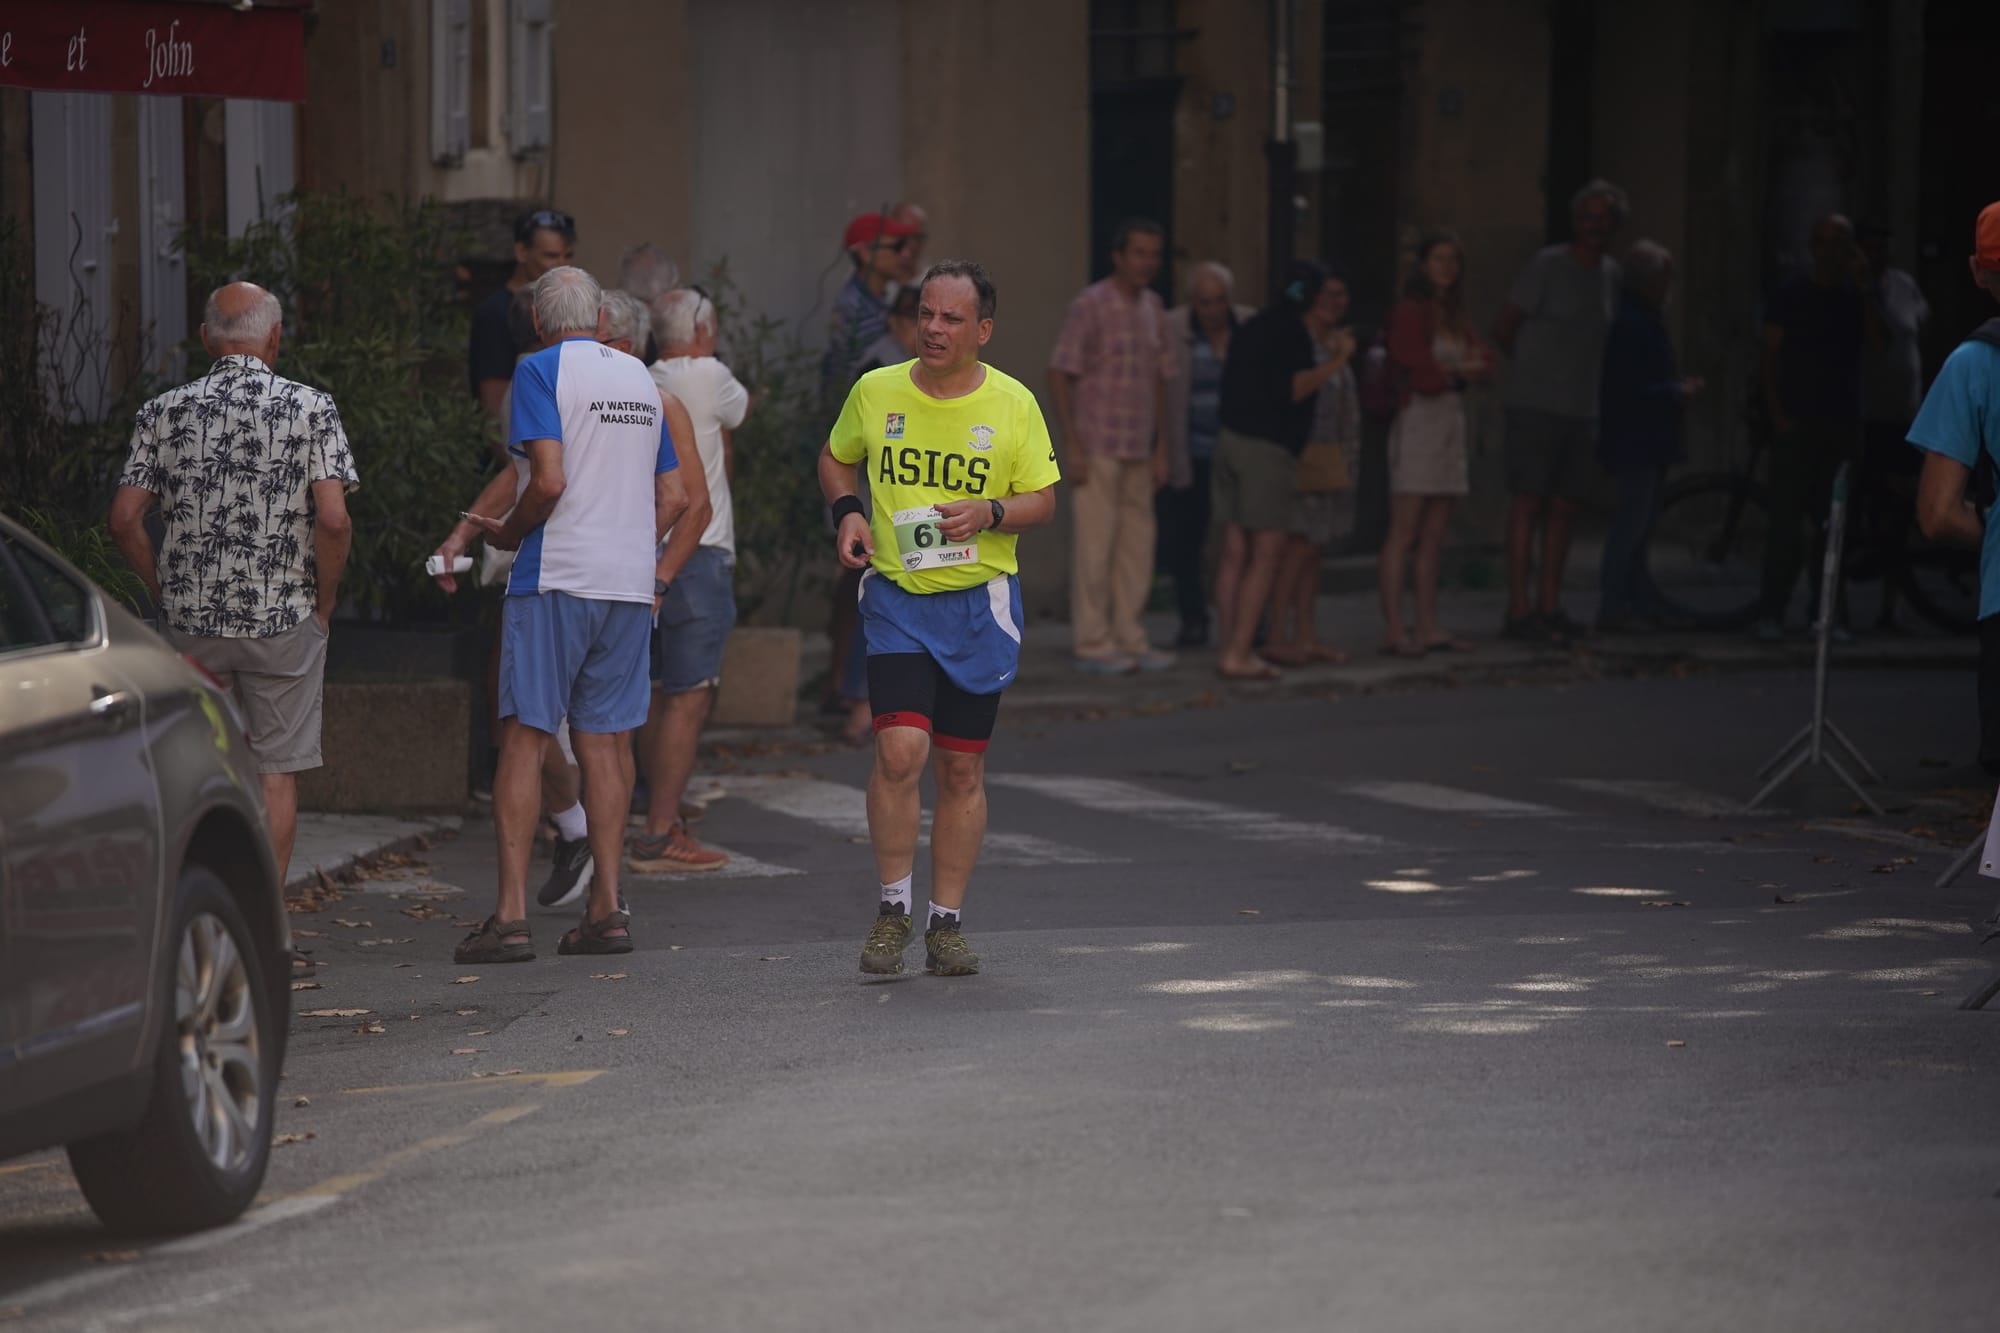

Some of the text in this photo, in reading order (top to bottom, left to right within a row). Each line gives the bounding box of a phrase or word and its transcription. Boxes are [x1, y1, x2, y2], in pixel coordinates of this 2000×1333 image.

[66, 27, 87, 71] et
[143, 19, 194, 88] John
[589, 401, 604, 412] AV
[880, 446, 990, 495] ASICS
